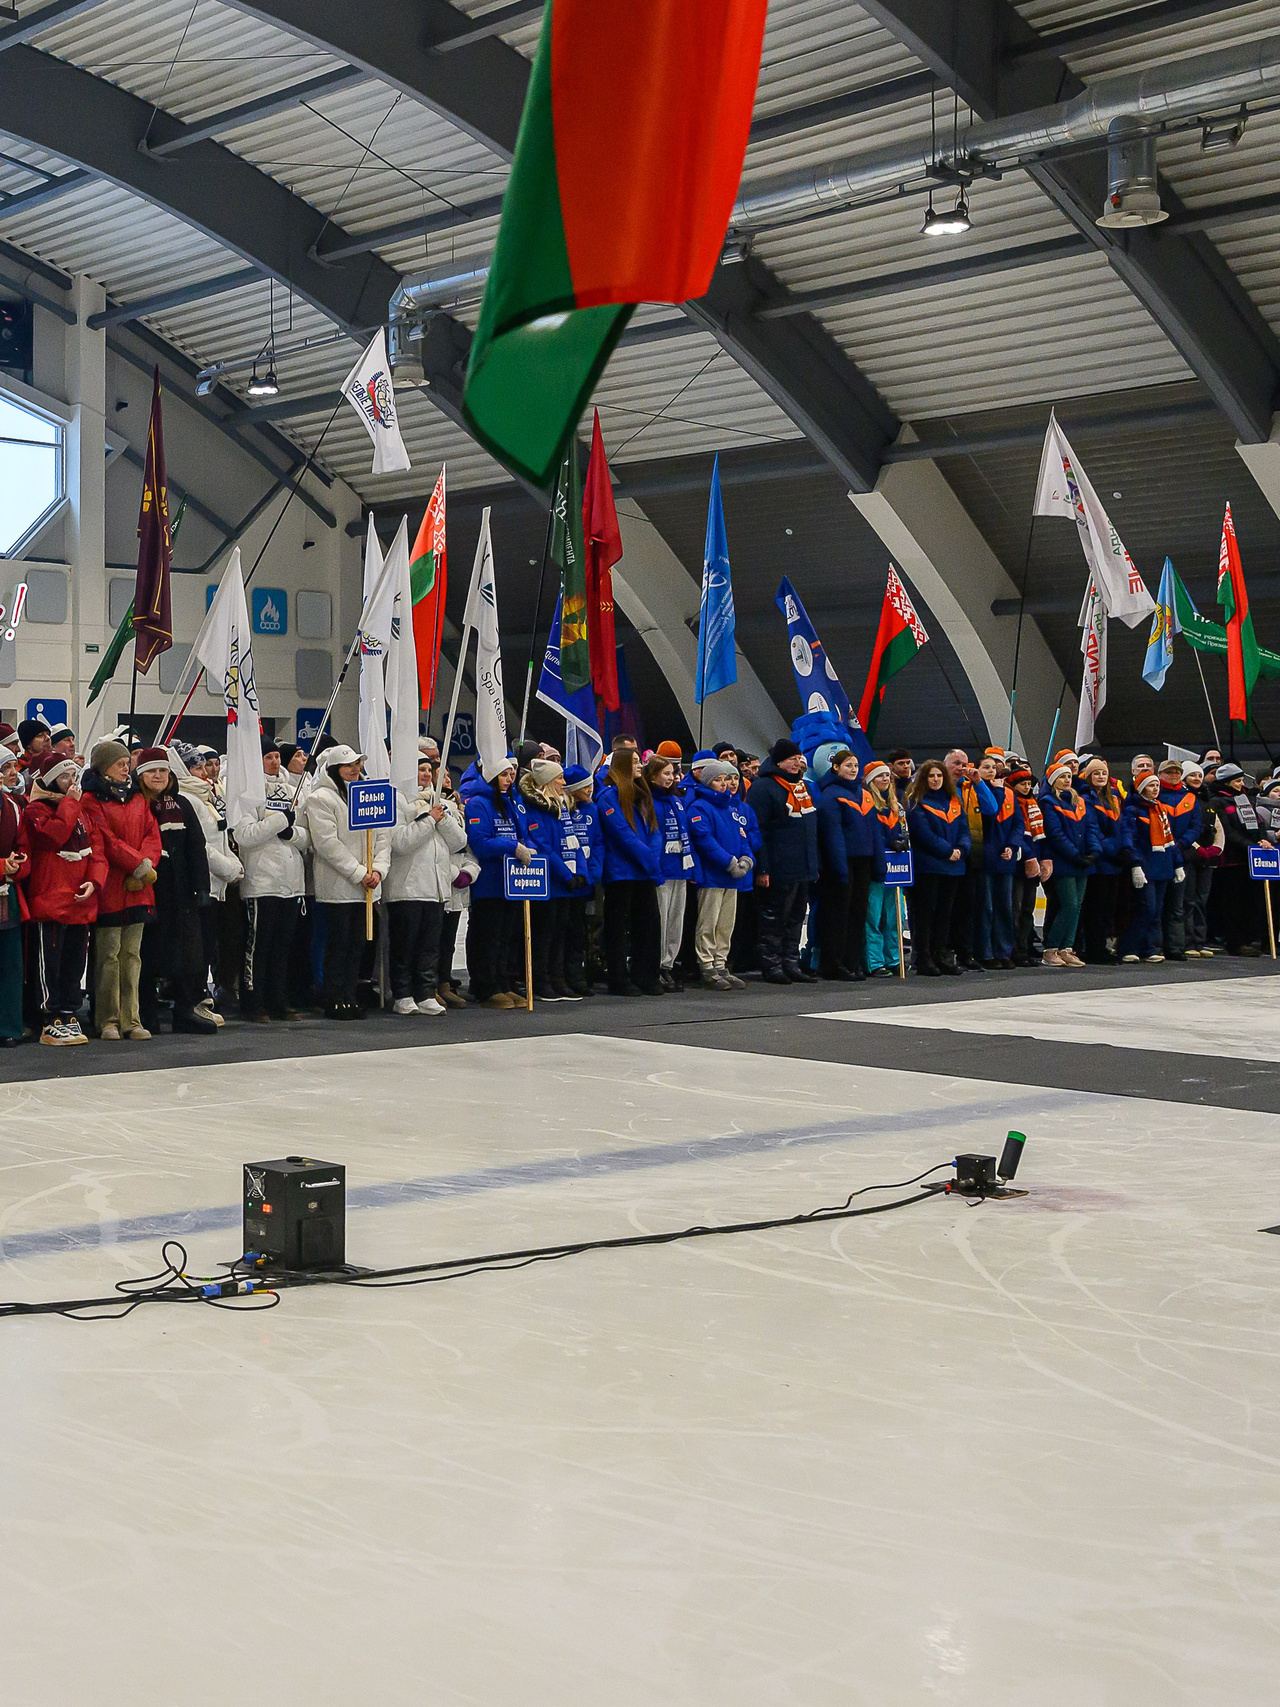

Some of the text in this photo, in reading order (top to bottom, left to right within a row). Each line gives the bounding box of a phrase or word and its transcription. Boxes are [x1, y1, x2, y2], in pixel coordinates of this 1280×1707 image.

[481, 671, 496, 696] Spa
[359, 790, 386, 803] Белые
[357, 805, 387, 819] тигры
[510, 864, 544, 876] Академия
[514, 878, 541, 890] сервиса
